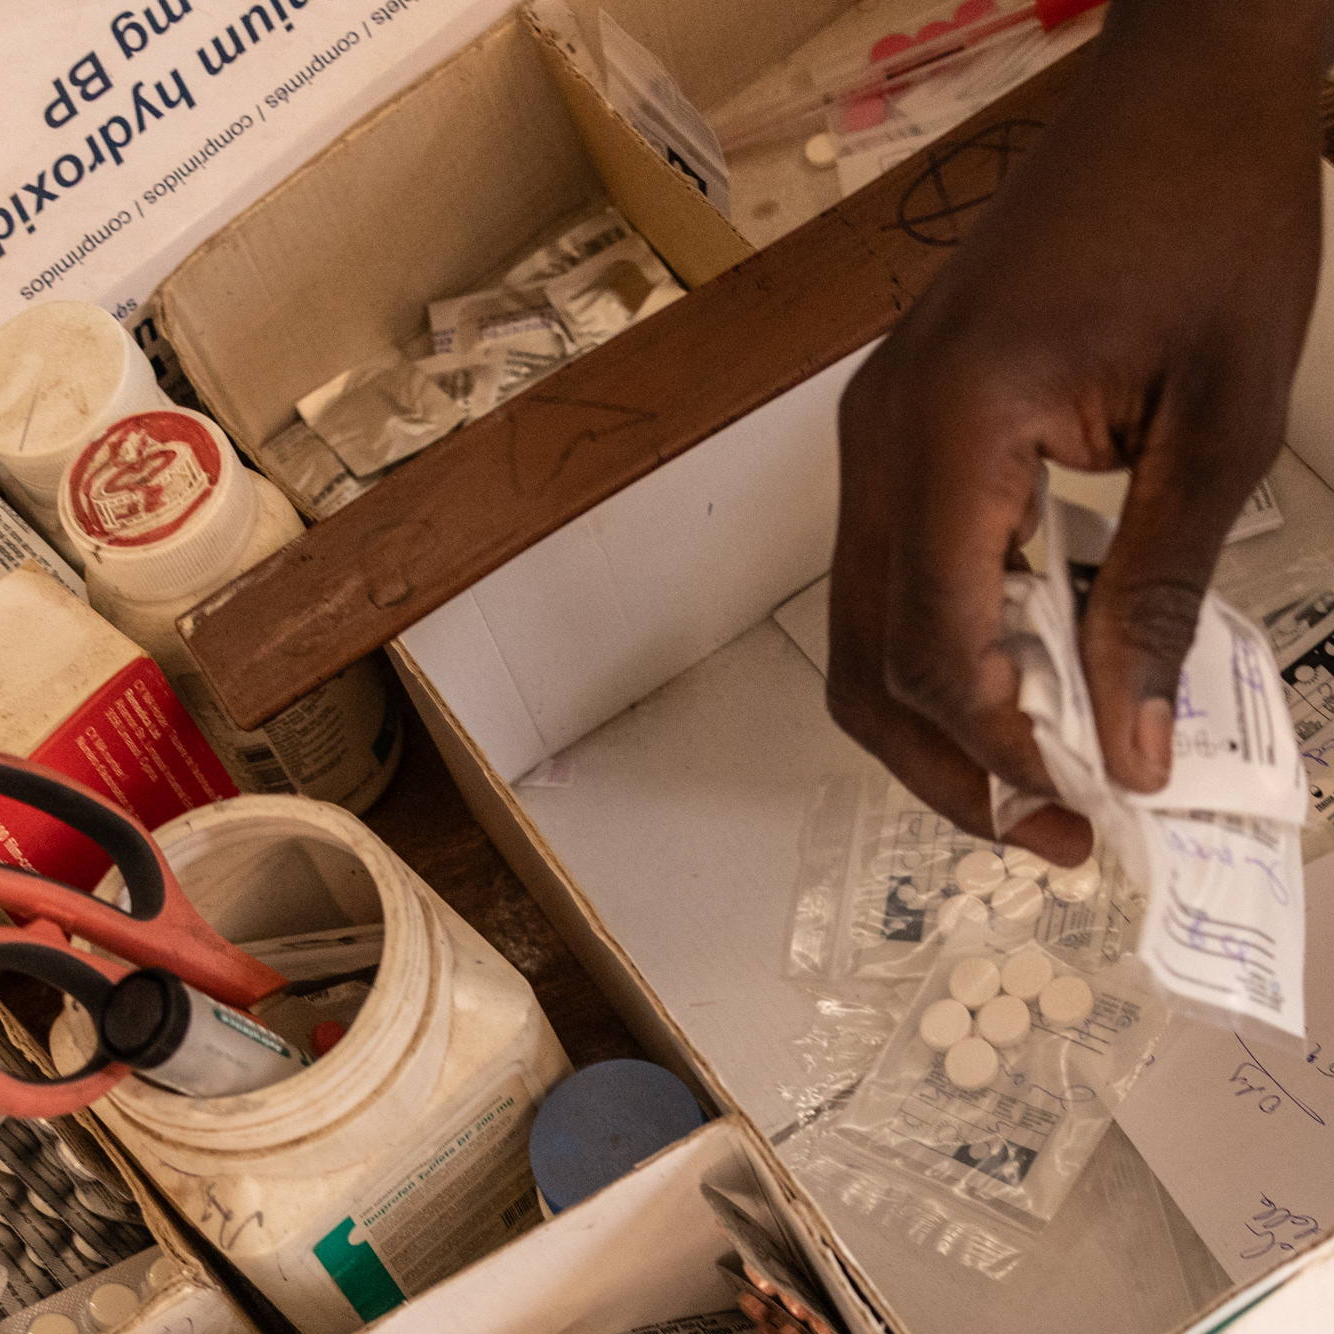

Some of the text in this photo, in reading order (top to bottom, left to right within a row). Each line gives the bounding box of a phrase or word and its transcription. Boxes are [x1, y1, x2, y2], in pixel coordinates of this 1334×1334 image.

[43, 51, 113, 129] BP
[263, 30, 361, 109] comprimés
[142, 114, 255, 205] comprimidos
[19, 210, 133, 301] comprimidos
